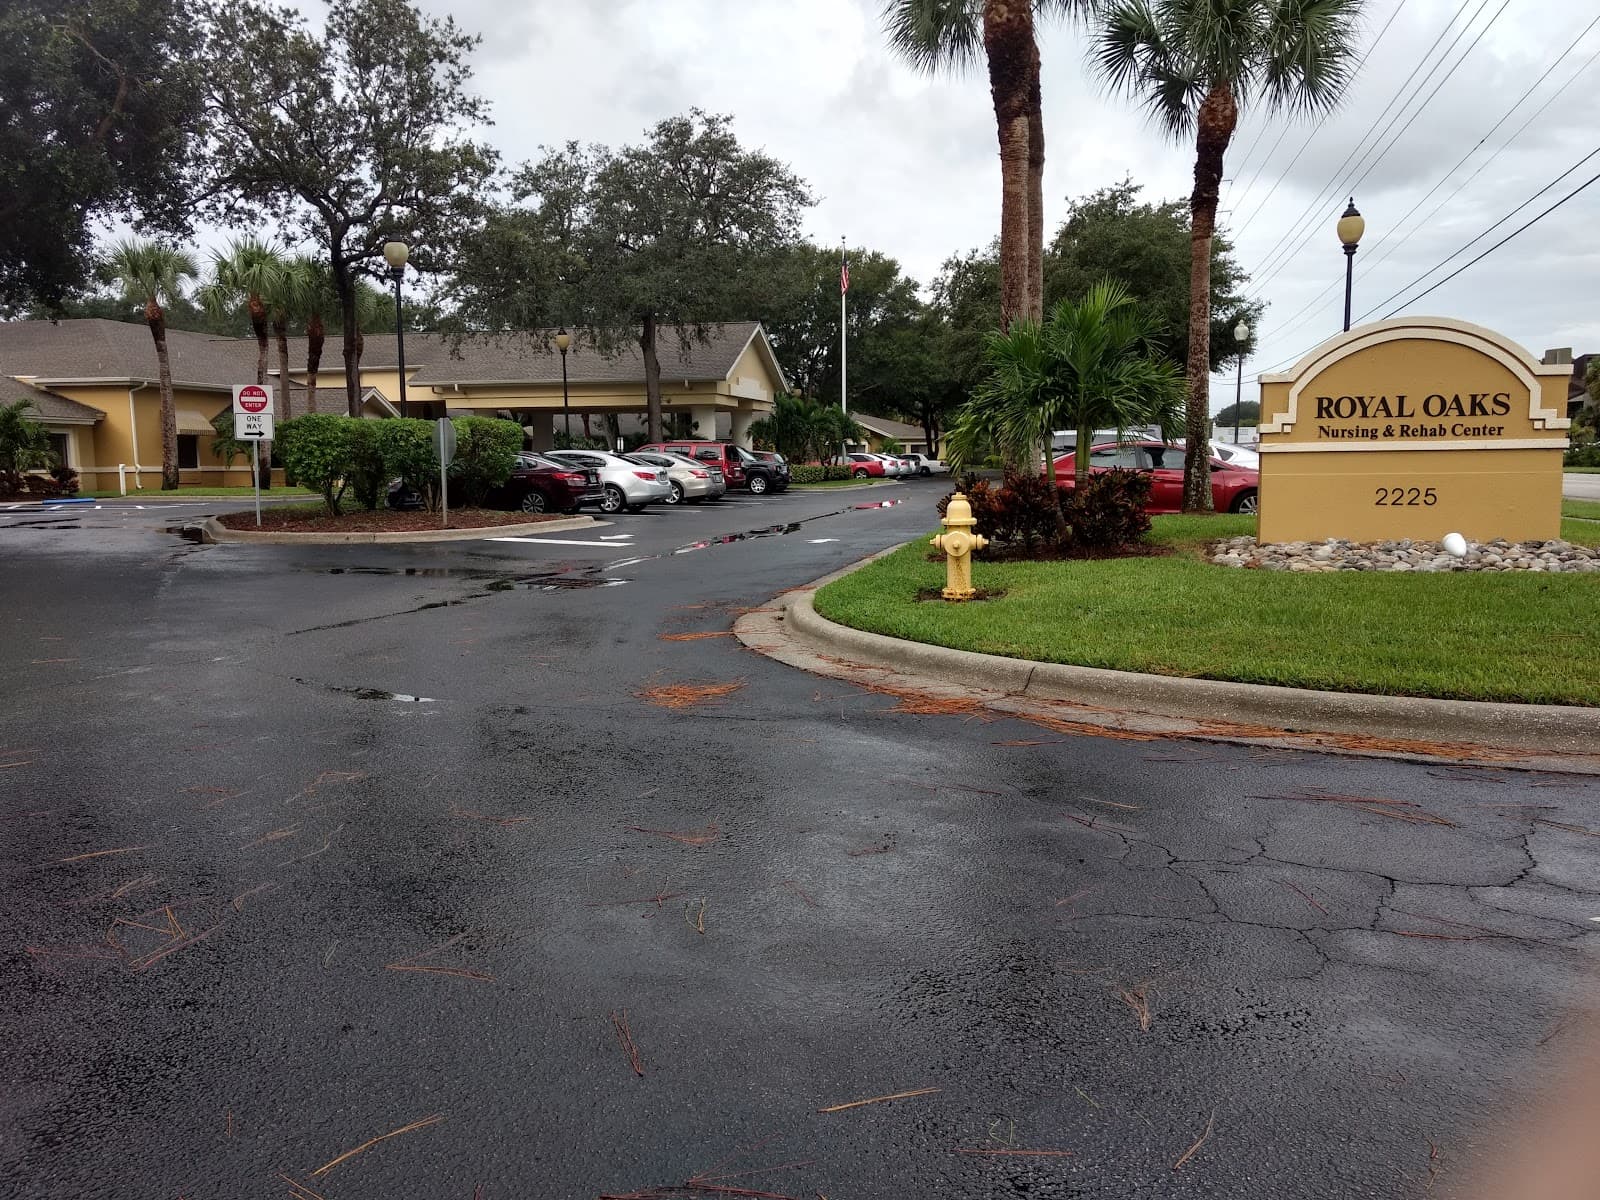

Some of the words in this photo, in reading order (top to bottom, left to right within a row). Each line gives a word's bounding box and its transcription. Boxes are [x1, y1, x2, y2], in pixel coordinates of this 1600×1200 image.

[1314, 395, 1415, 419] ROYAL
[1422, 392, 1511, 417] OAKS
[1318, 425, 1378, 440] Nursing
[1382, 424, 1395, 438] &
[1399, 423, 1447, 438] Rehab
[1451, 423, 1505, 437] Center
[1375, 487, 1438, 506] 2225
